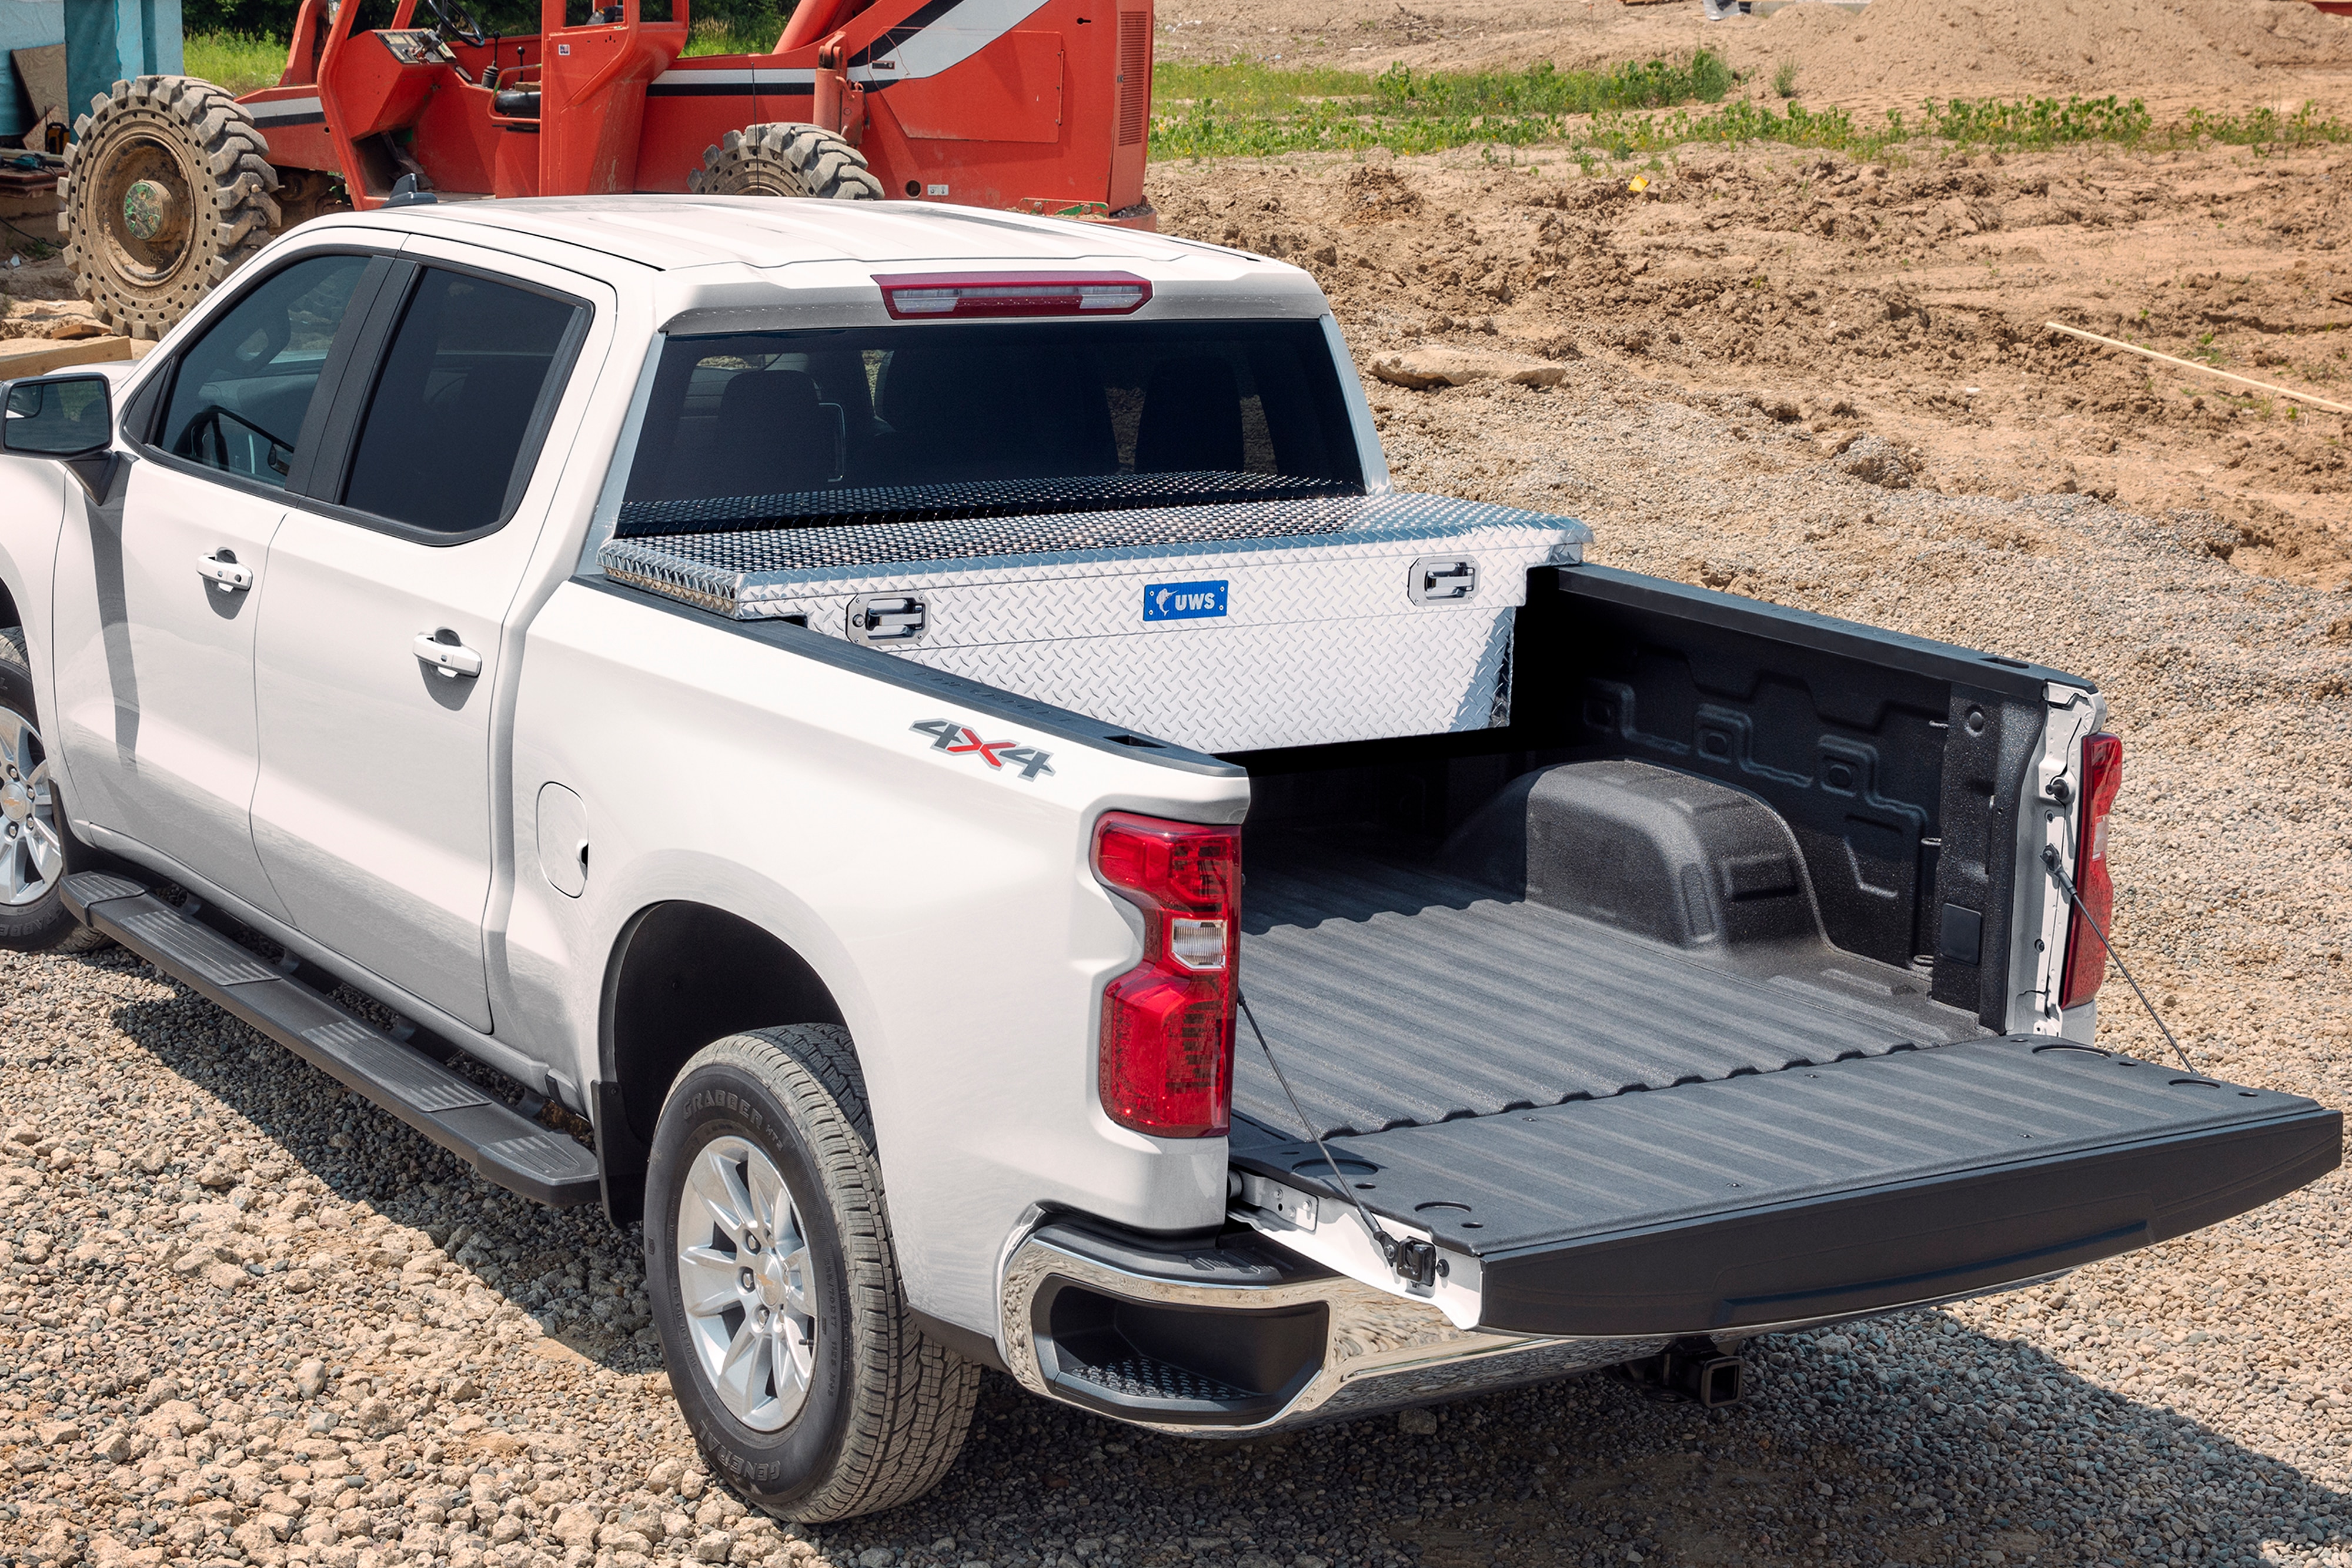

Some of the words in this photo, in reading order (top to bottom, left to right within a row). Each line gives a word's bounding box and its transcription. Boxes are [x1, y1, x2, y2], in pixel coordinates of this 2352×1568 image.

[1175, 592, 1215, 611] UWS
[683, 1089, 763, 1130] GRABBER
[698, 1419, 780, 1481] GENERAL
